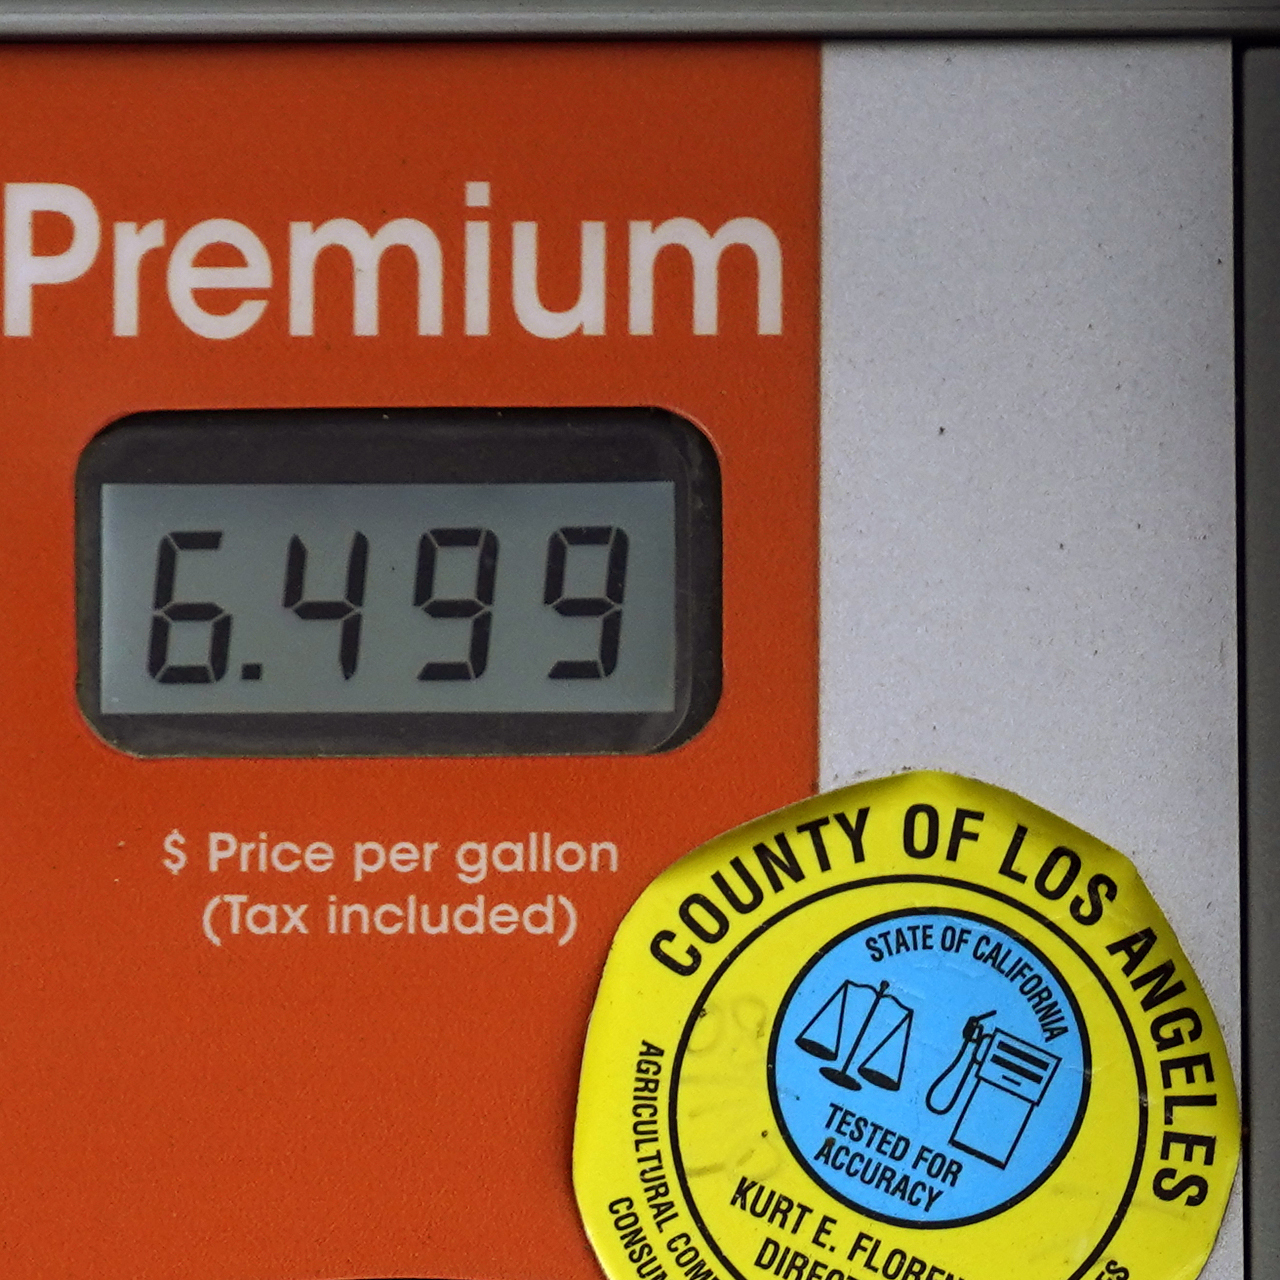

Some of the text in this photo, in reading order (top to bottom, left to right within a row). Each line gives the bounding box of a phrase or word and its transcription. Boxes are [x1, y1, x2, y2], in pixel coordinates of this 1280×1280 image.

[2, 182, 785, 340] Premium
[148, 526, 632, 685] 6.499
[163, 832, 620, 884] $ Price per gallon
[203, 894, 578, 946] (Tax included)
[649, 803, 1218, 1208] COUNTY OF LOS ANGELES
[865, 923, 1071, 1044] STATE OF CALIFORNIA
[630, 1038, 685, 1234] AGRICULTURAL
[814, 1137, 944, 1214] ACCURACY
[823, 1103, 966, 1188] TESTED FOR
[731, 1177, 814, 1234] KURT
[814, 1215, 838, 1254] E.
